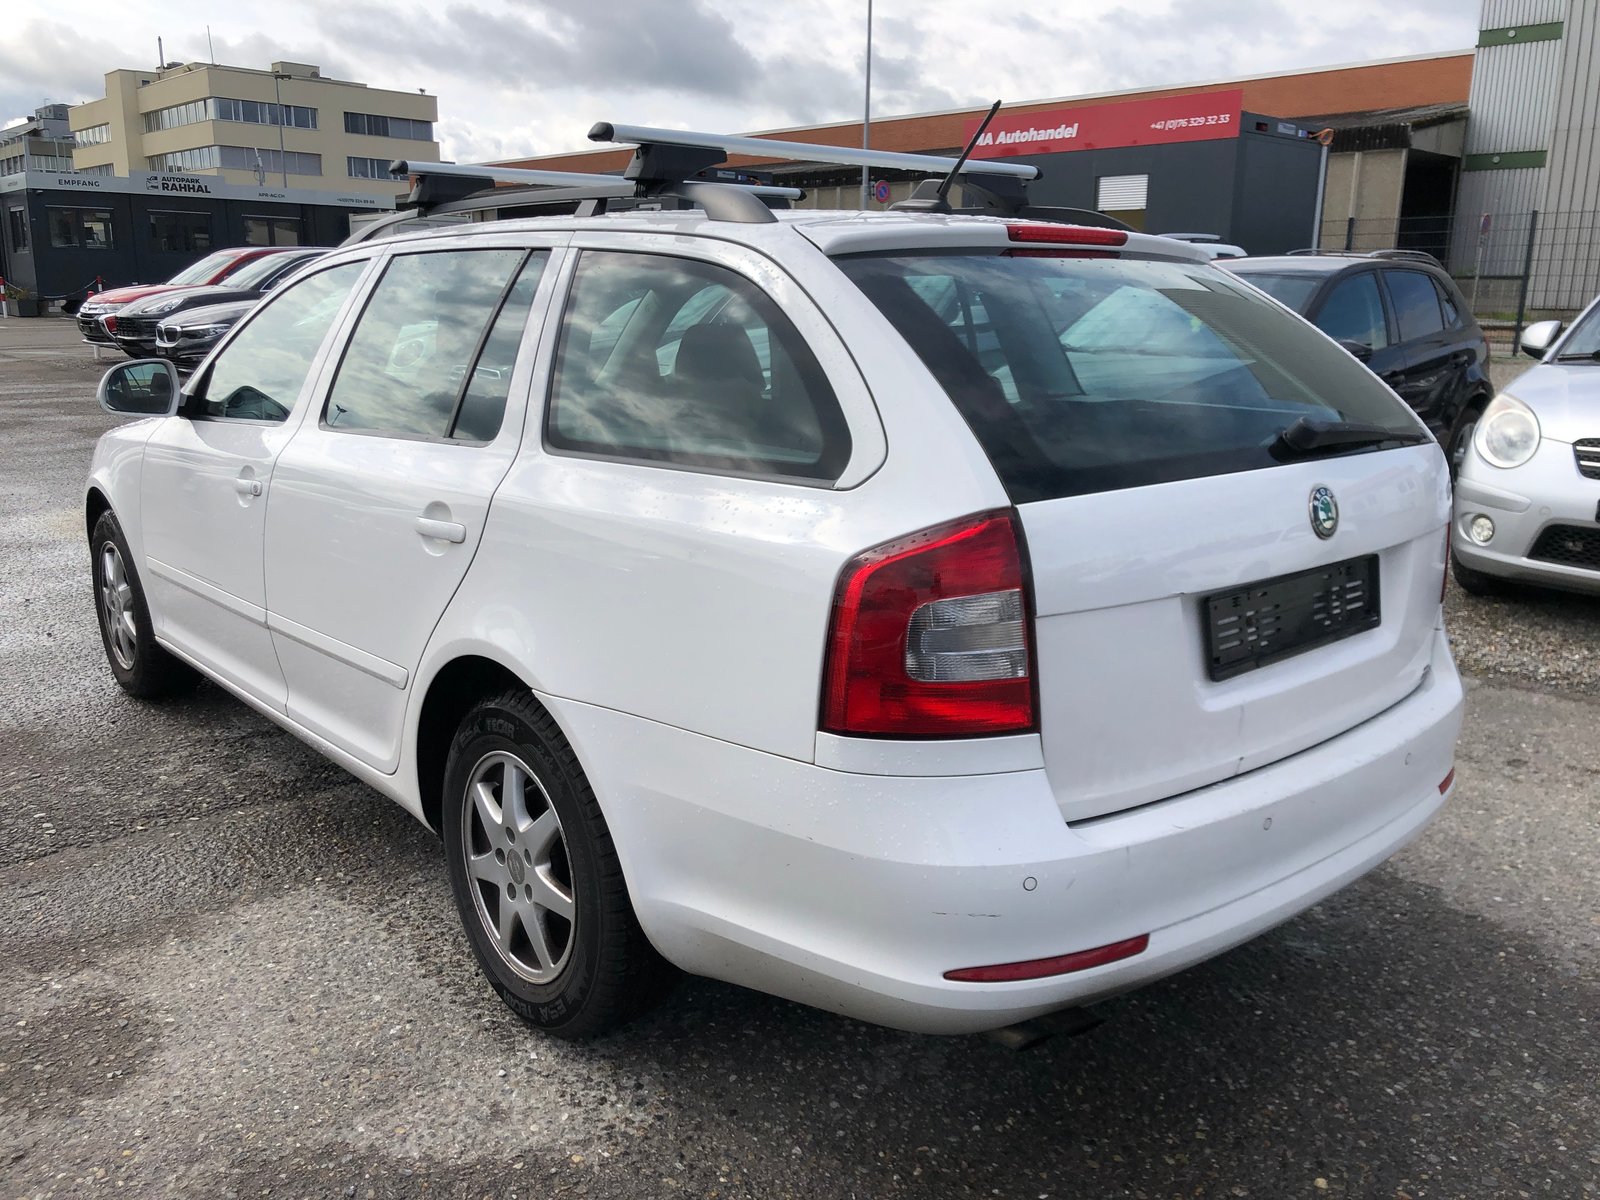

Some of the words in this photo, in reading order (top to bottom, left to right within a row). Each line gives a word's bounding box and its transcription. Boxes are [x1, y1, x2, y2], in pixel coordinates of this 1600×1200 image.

[1188, 116, 1206, 127] 329
[1205, 115, 1218, 125] 32
[1217, 113, 1231, 124] 33
[994, 122, 1079, 145] Autohandel
[58, 179, 100, 187] EMPFANG
[161, 176, 201, 184] AUTOPARK
[161, 182, 211, 194] RAHHAL
